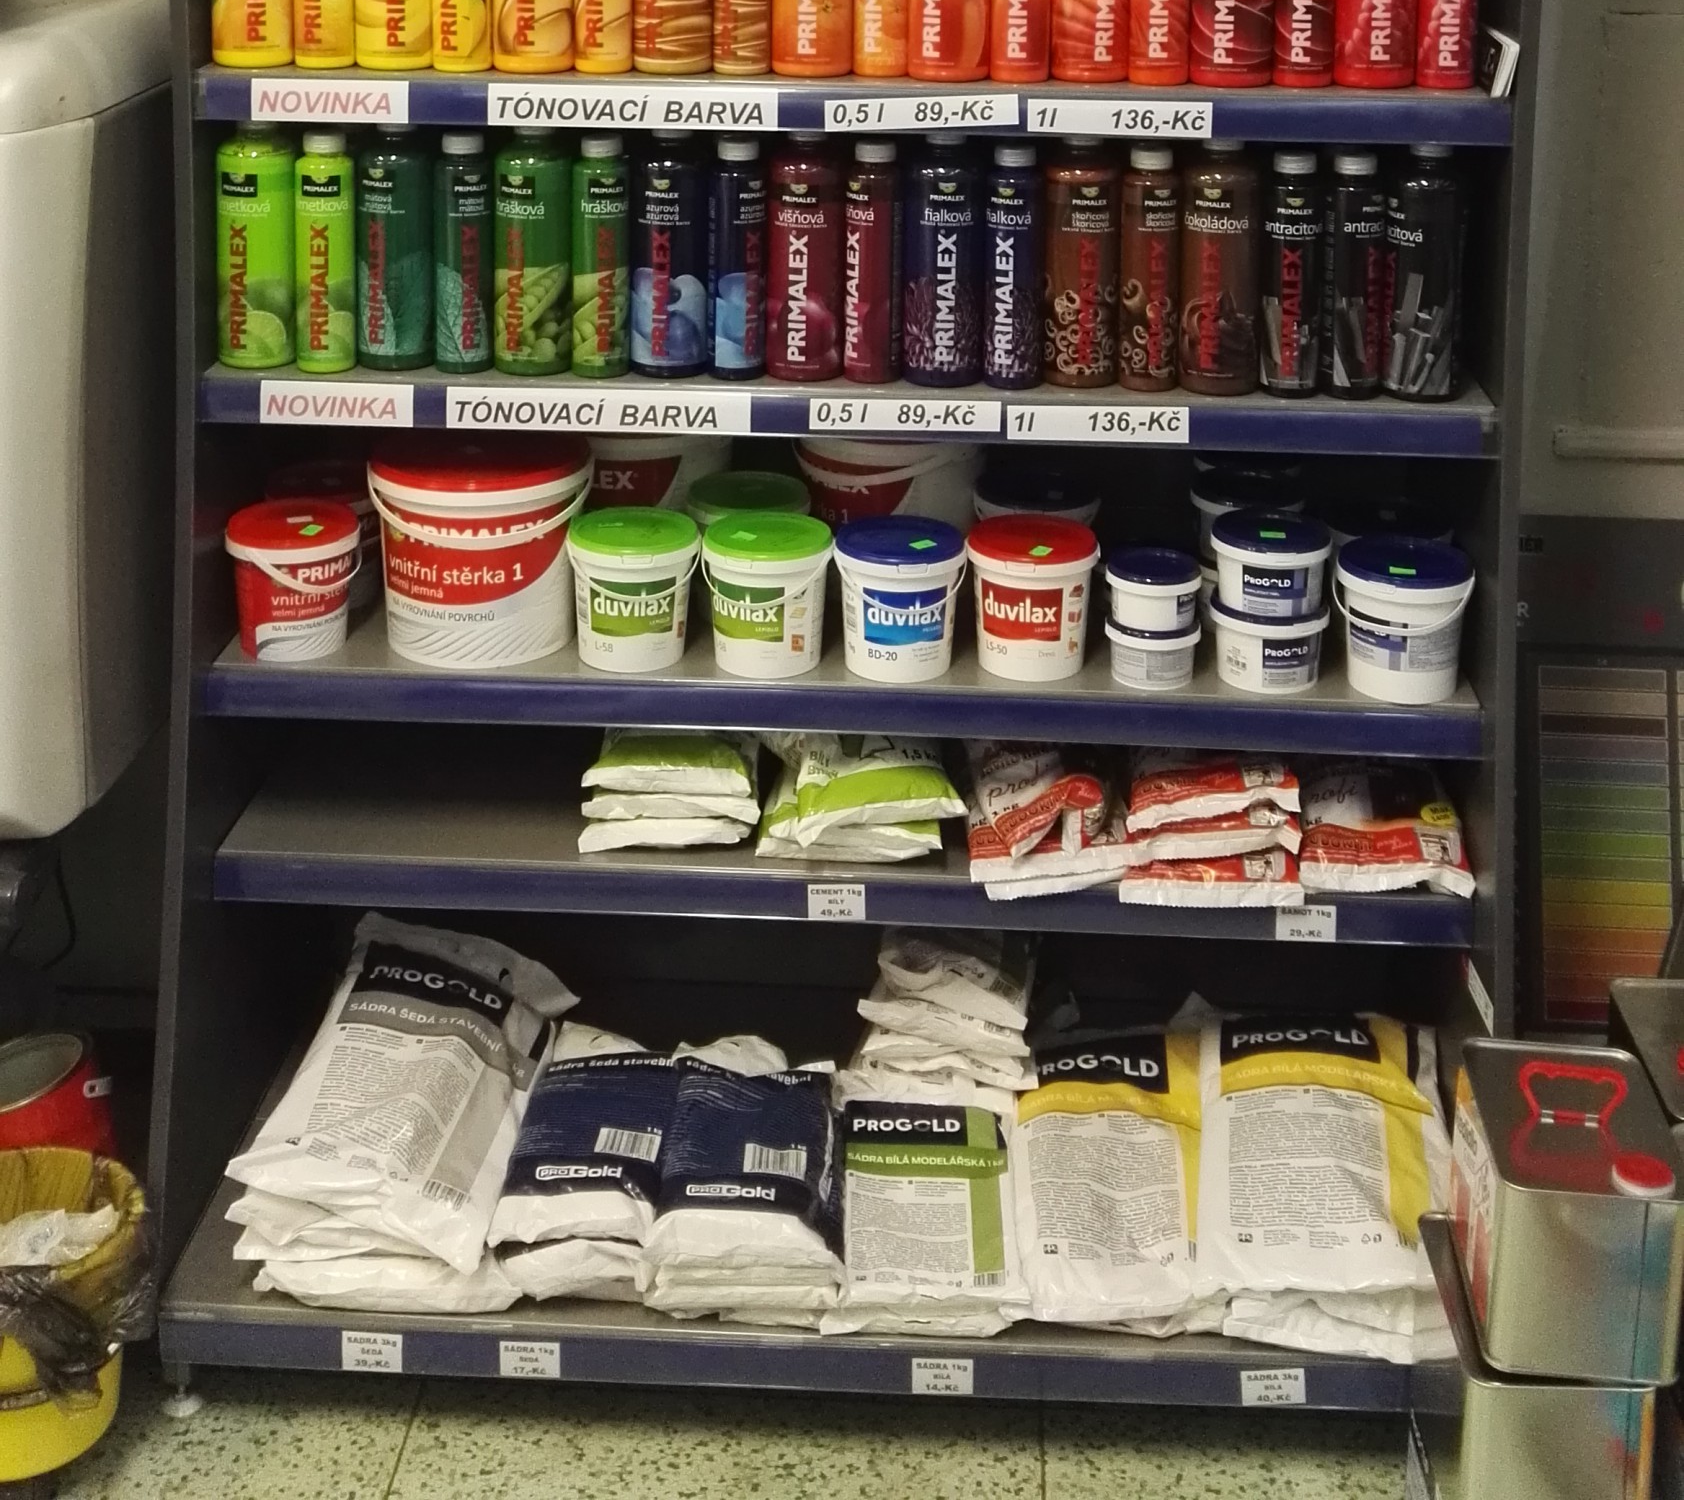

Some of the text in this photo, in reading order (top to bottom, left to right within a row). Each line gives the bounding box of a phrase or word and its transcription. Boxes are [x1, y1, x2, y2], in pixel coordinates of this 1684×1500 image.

[259, 90, 392, 115] NOVINKA
[497, 94, 764, 126] TÓNOVACÍ BARVA
[832, 104, 869, 125] 0,5
[914, 99, 994, 124] 89,-Kč
[1110, 109, 1206, 132] 136,-Kč
[782, 195, 817, 203] PRIMALEX
[1196, 200, 1231, 208] PRIMALEX
[778, 210, 824, 223] višňová
[925, 208, 971, 222] fialková
[1185, 213, 1249, 229] čokoládová
[230, 224, 247, 349] PRIMALEX
[310, 224, 329, 351] PRIMALEX
[652, 230, 669, 356] PRIMALEX
[787, 234, 809, 361] PRIMALEX
[845, 231, 860, 358] PRIMALEX
[935, 233, 957, 362] PRIMALEX
[994, 237, 1014, 365] PRIMALEX
[266, 395, 397, 420] NOVINKA
[455, 397, 719, 430] TÓNOVACÍ BARVA
[817, 403, 854, 425] 0,5
[897, 405, 976, 427] 89,-Kč
[1087, 411, 1181, 434] 136,-Kč
[389, 554, 523, 585] vnitřní stěrka 1
[410, 581, 444, 599] jemná
[272, 605, 325, 617] velmi jemná
[401, 600, 494, 622] VYROVNÁNÍ POVRCHŮ
[594, 589, 670, 617] duvilax
[867, 597, 942, 625] duvilax
[985, 591, 1056, 623] duvilax
[595, 642, 613, 652] L-58
[868, 649, 897, 661] BD-20
[986, 640, 1007, 655] LS-50
[820, 909, 852, 917] 49,-Kč
[1317, 910, 1331, 918] 1kg
[349, 1002, 502, 1051] SÁDRA ŠEDÁ STAVEBNÍ
[589, 1059, 619, 1067] šedá
[624, 1059, 674, 1067] stavebn
[848, 1153, 985, 1167] SÁDRA BÍLÁ MODELÁŘSKÁ
[916, 1362, 948, 1370] SÁDRA
